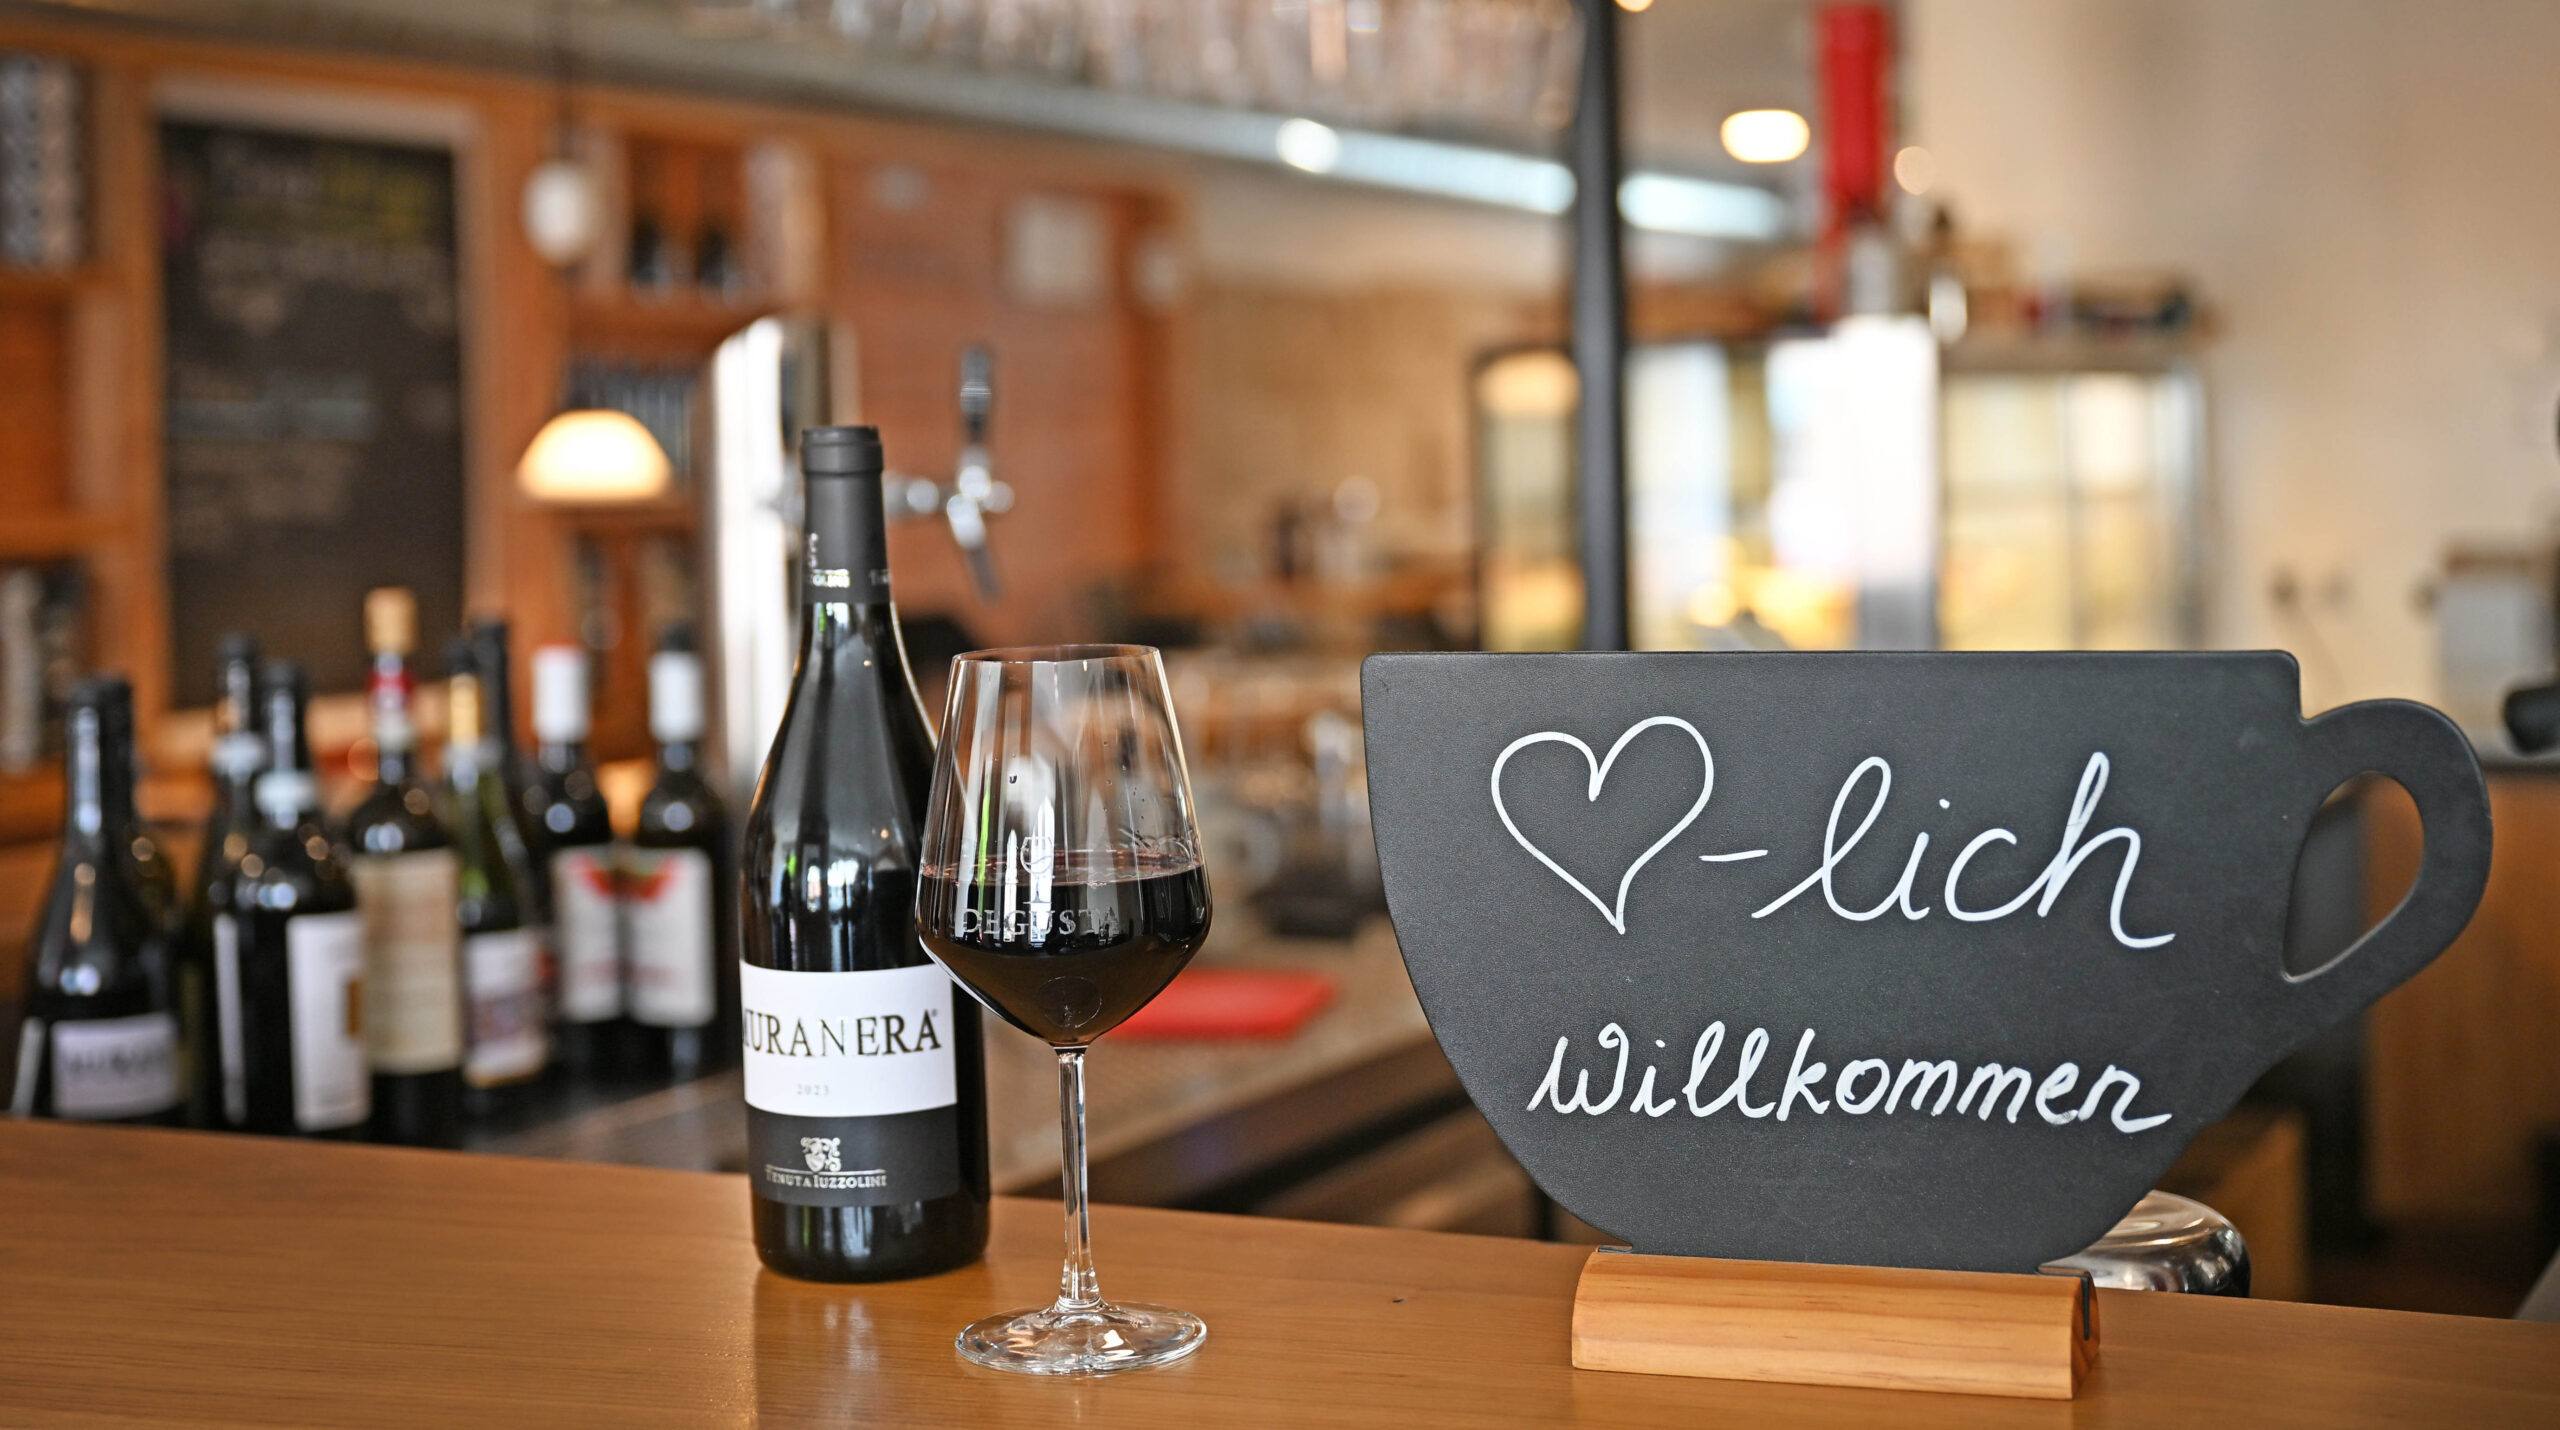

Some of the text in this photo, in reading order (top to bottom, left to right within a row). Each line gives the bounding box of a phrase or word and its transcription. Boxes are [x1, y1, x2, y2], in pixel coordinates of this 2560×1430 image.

[960, 907, 1120, 937] DEGUSTA
[796, 1083, 830, 1096] 2023
[1526, 1020, 2173, 1133] Willkommen
